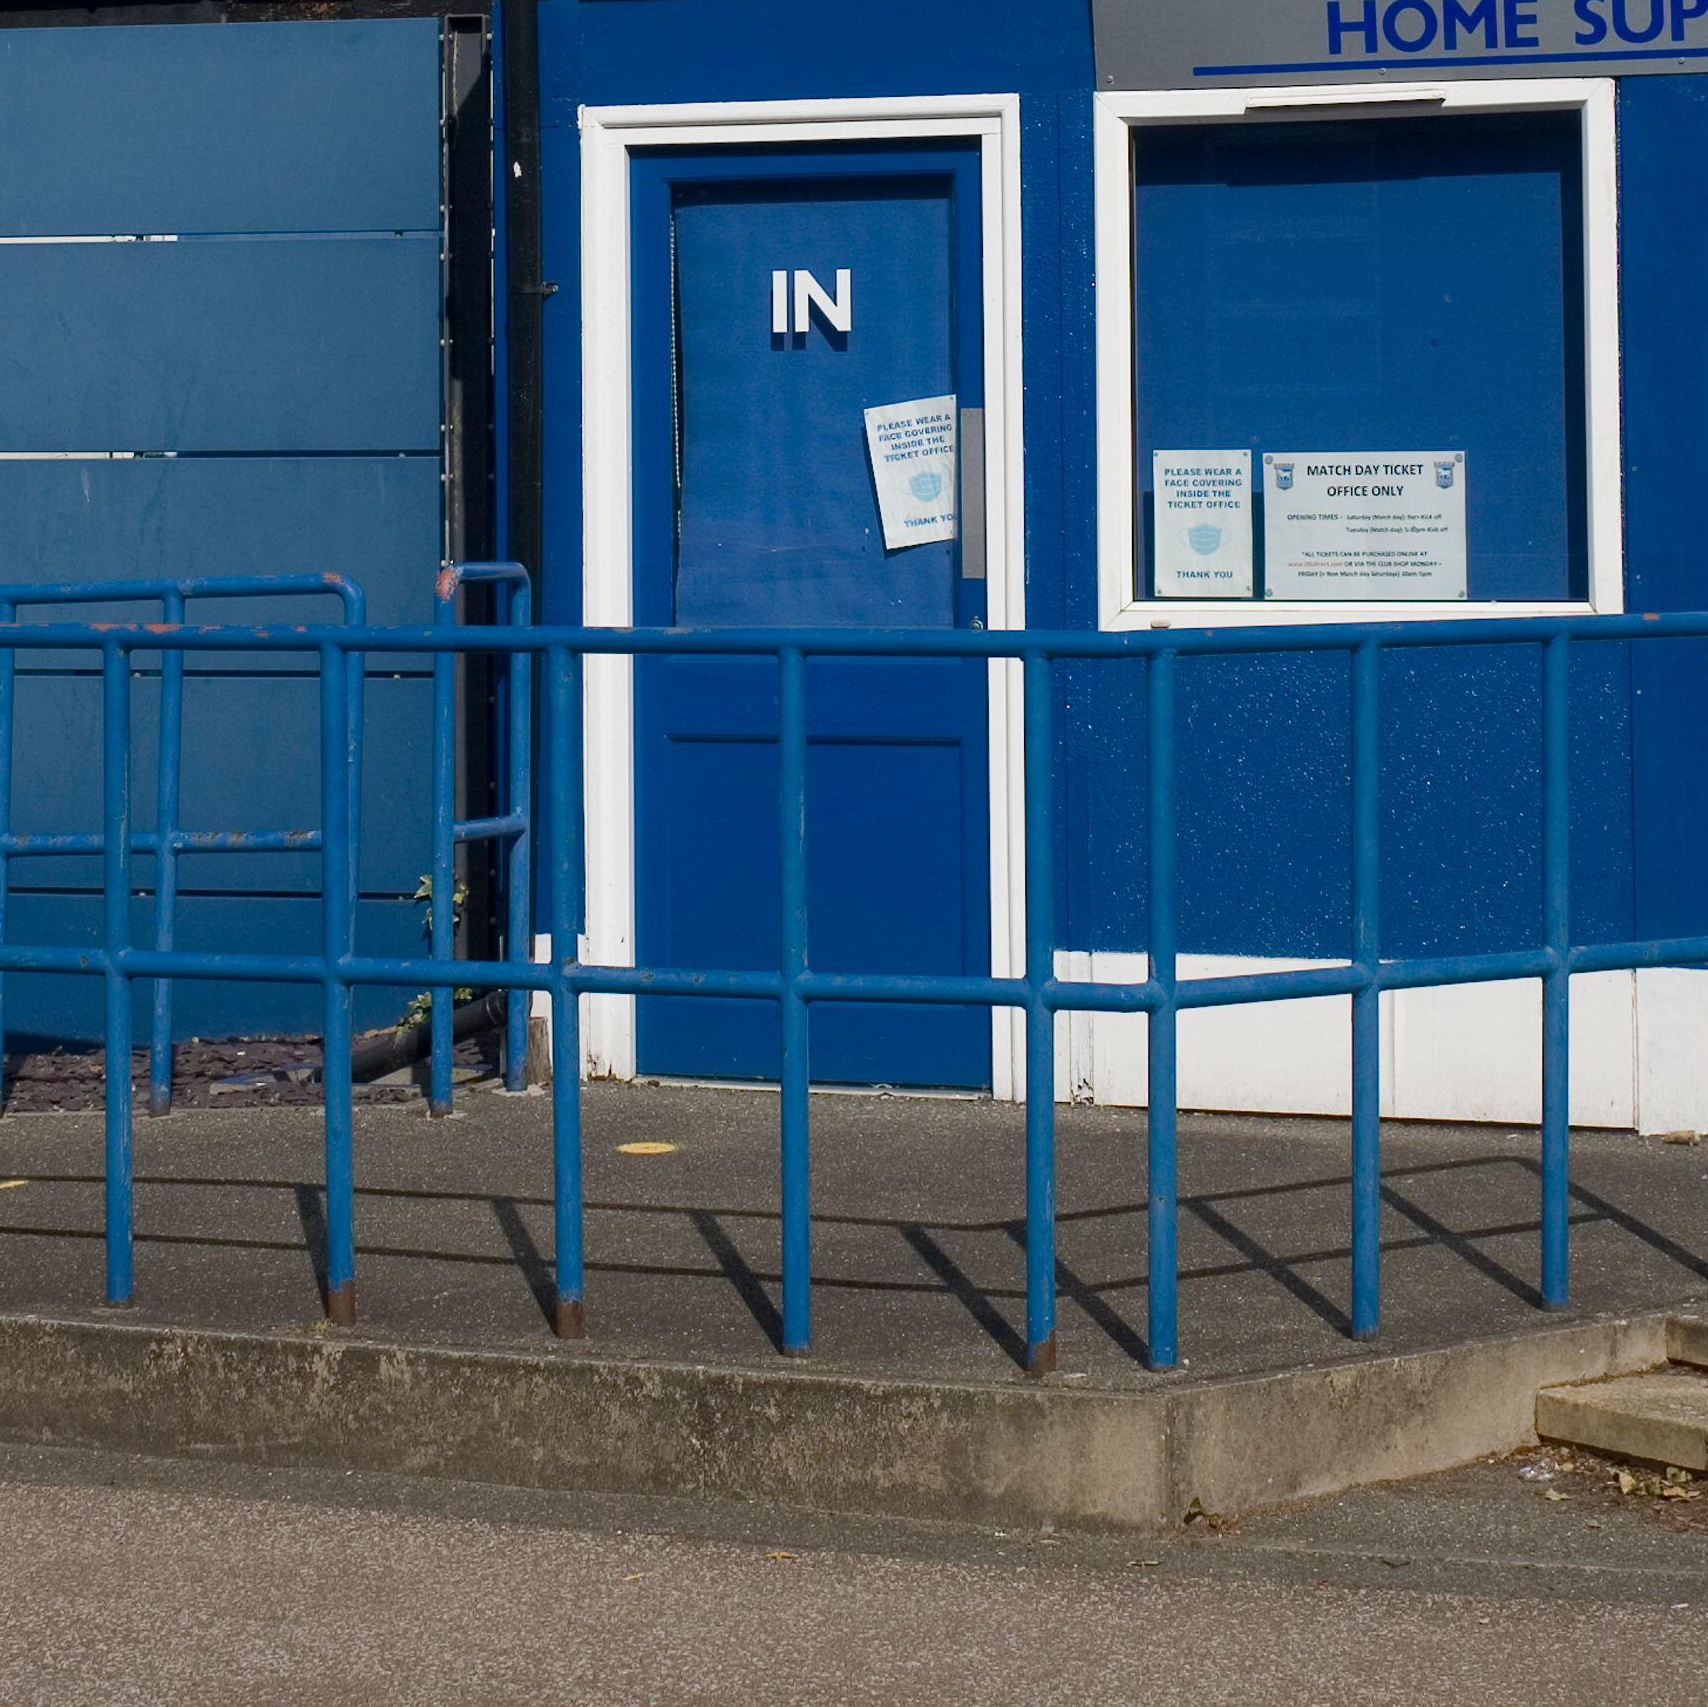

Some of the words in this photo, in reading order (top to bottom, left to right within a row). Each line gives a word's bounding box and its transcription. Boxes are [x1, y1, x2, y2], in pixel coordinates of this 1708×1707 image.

[772, 268, 852, 333] IN
[876, 418, 912, 432] PLEASE
[915, 414, 942, 425] WEAR
[944, 413, 951, 421] A
[878, 432, 902, 443] FACE
[904, 423, 953, 438] COVERING
[891, 438, 923, 451] INSIDE
[926, 435, 945, 445] THE
[884, 450, 919, 463] TICKET
[922, 444, 954, 457] OFFICE
[1164, 467, 1203, 476] PLEASE
[1204, 467, 1233, 476] WEAR
[1235, 467, 1242, 476] A
[1307, 465, 1351, 476] MATCH
[1355, 465, 1380, 476] DAY
[1382, 464, 1424, 475] TICKET
[1164, 478, 1189, 487] FACE
[1192, 478, 1243, 487] COVERING
[1176, 490, 1210, 498] INSIDE
[1212, 490, 1231, 498] THE
[1327, 486, 1368, 497] OFFICE
[1371, 485, 1404, 496] ONLY
[1167, 500, 1203, 509] TICKET
[1206, 500, 1241, 509] OFFICE
[903, 516, 938, 528] THANK
[1318, 513, 1339, 521] TIMES
[1316, 550, 1339, 558] TICKETS
[1339, 550, 1353, 558] CAN
[1176, 570, 1211, 579] THANK
[1213, 570, 1233, 579] YOU
